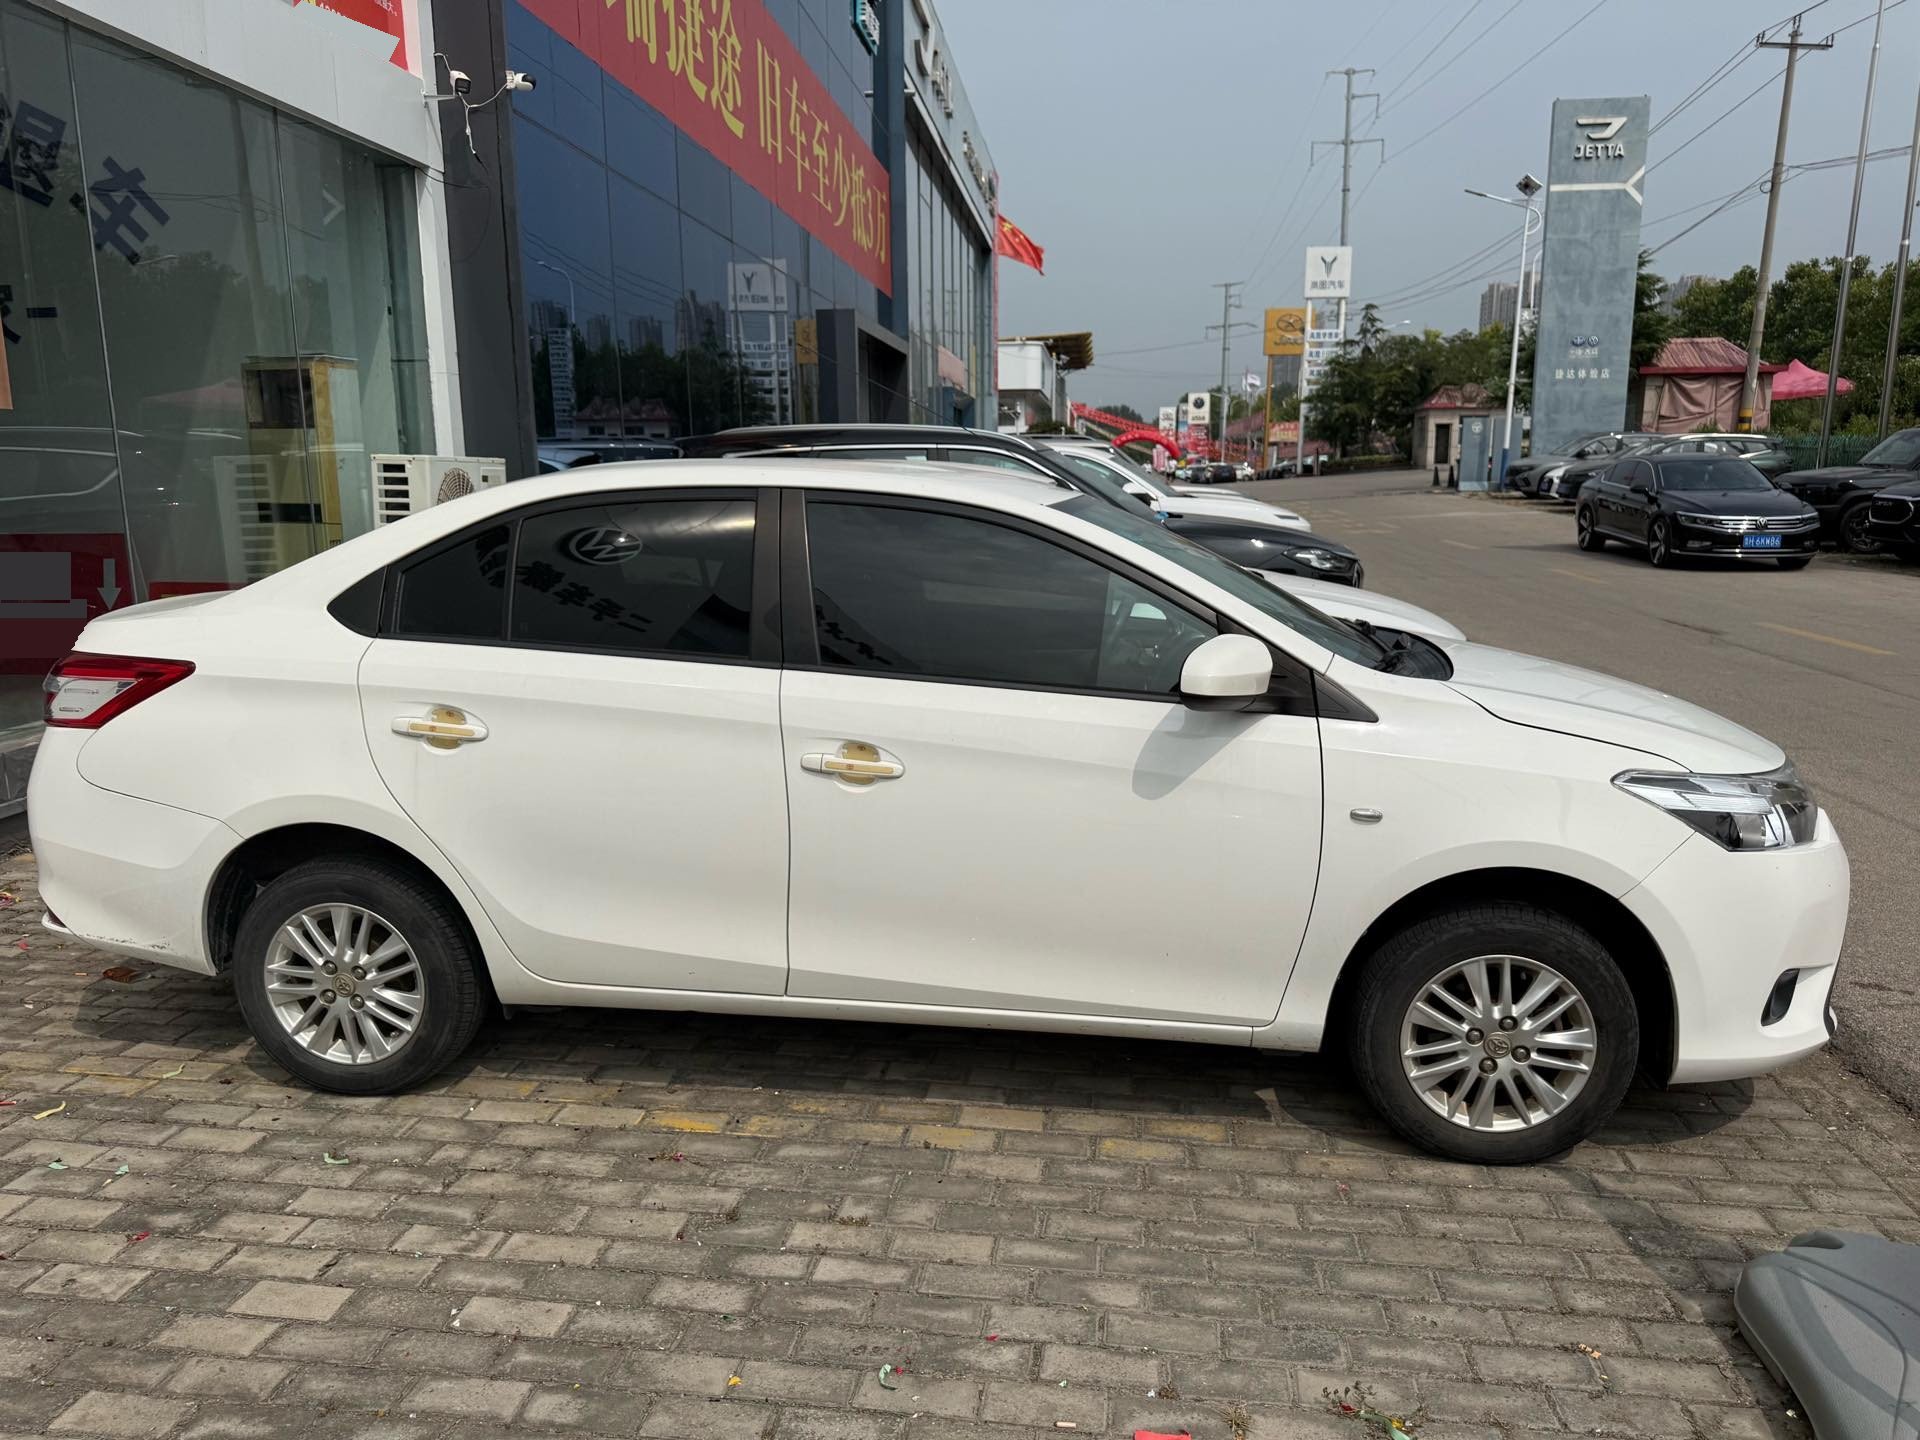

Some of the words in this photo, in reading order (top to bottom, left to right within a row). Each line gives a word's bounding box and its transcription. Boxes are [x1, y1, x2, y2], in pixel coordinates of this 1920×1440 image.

[756, 36, 888, 245] 旧车至少抵3万
[1574, 143, 1625, 160] JETTA
[1554, 367, 1610, 379] 捷达体验店
